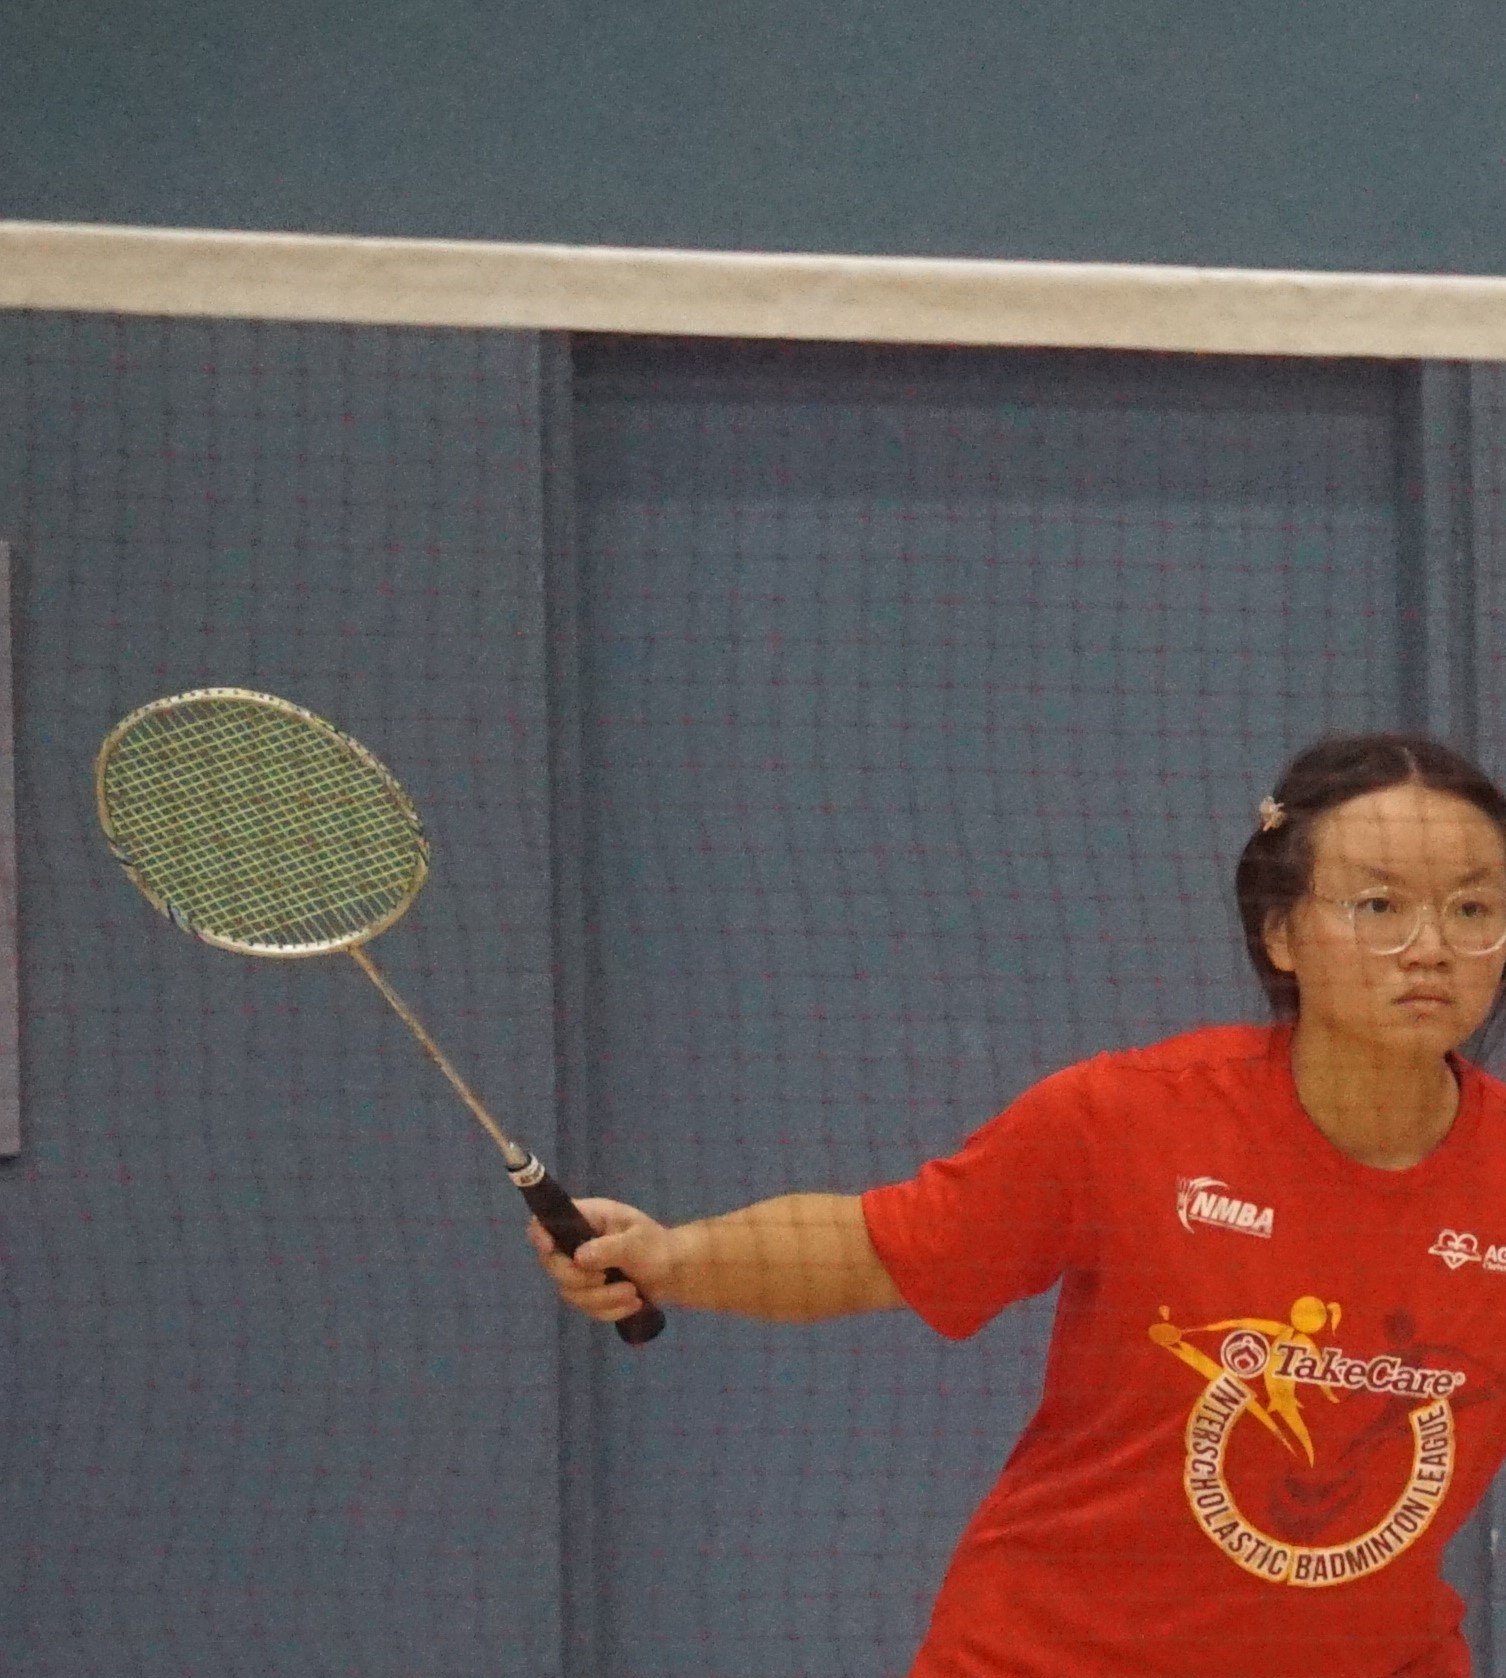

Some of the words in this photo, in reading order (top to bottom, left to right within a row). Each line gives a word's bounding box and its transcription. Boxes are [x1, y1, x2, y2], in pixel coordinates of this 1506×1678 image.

[1189, 1191, 1274, 1235] NMBA
[1190, 1376, 1288, 1577] INTERSCHOLASTIC
[1294, 1497, 1430, 1582] BADMINTON
[1411, 1404, 1449, 1497] LEAGUE
